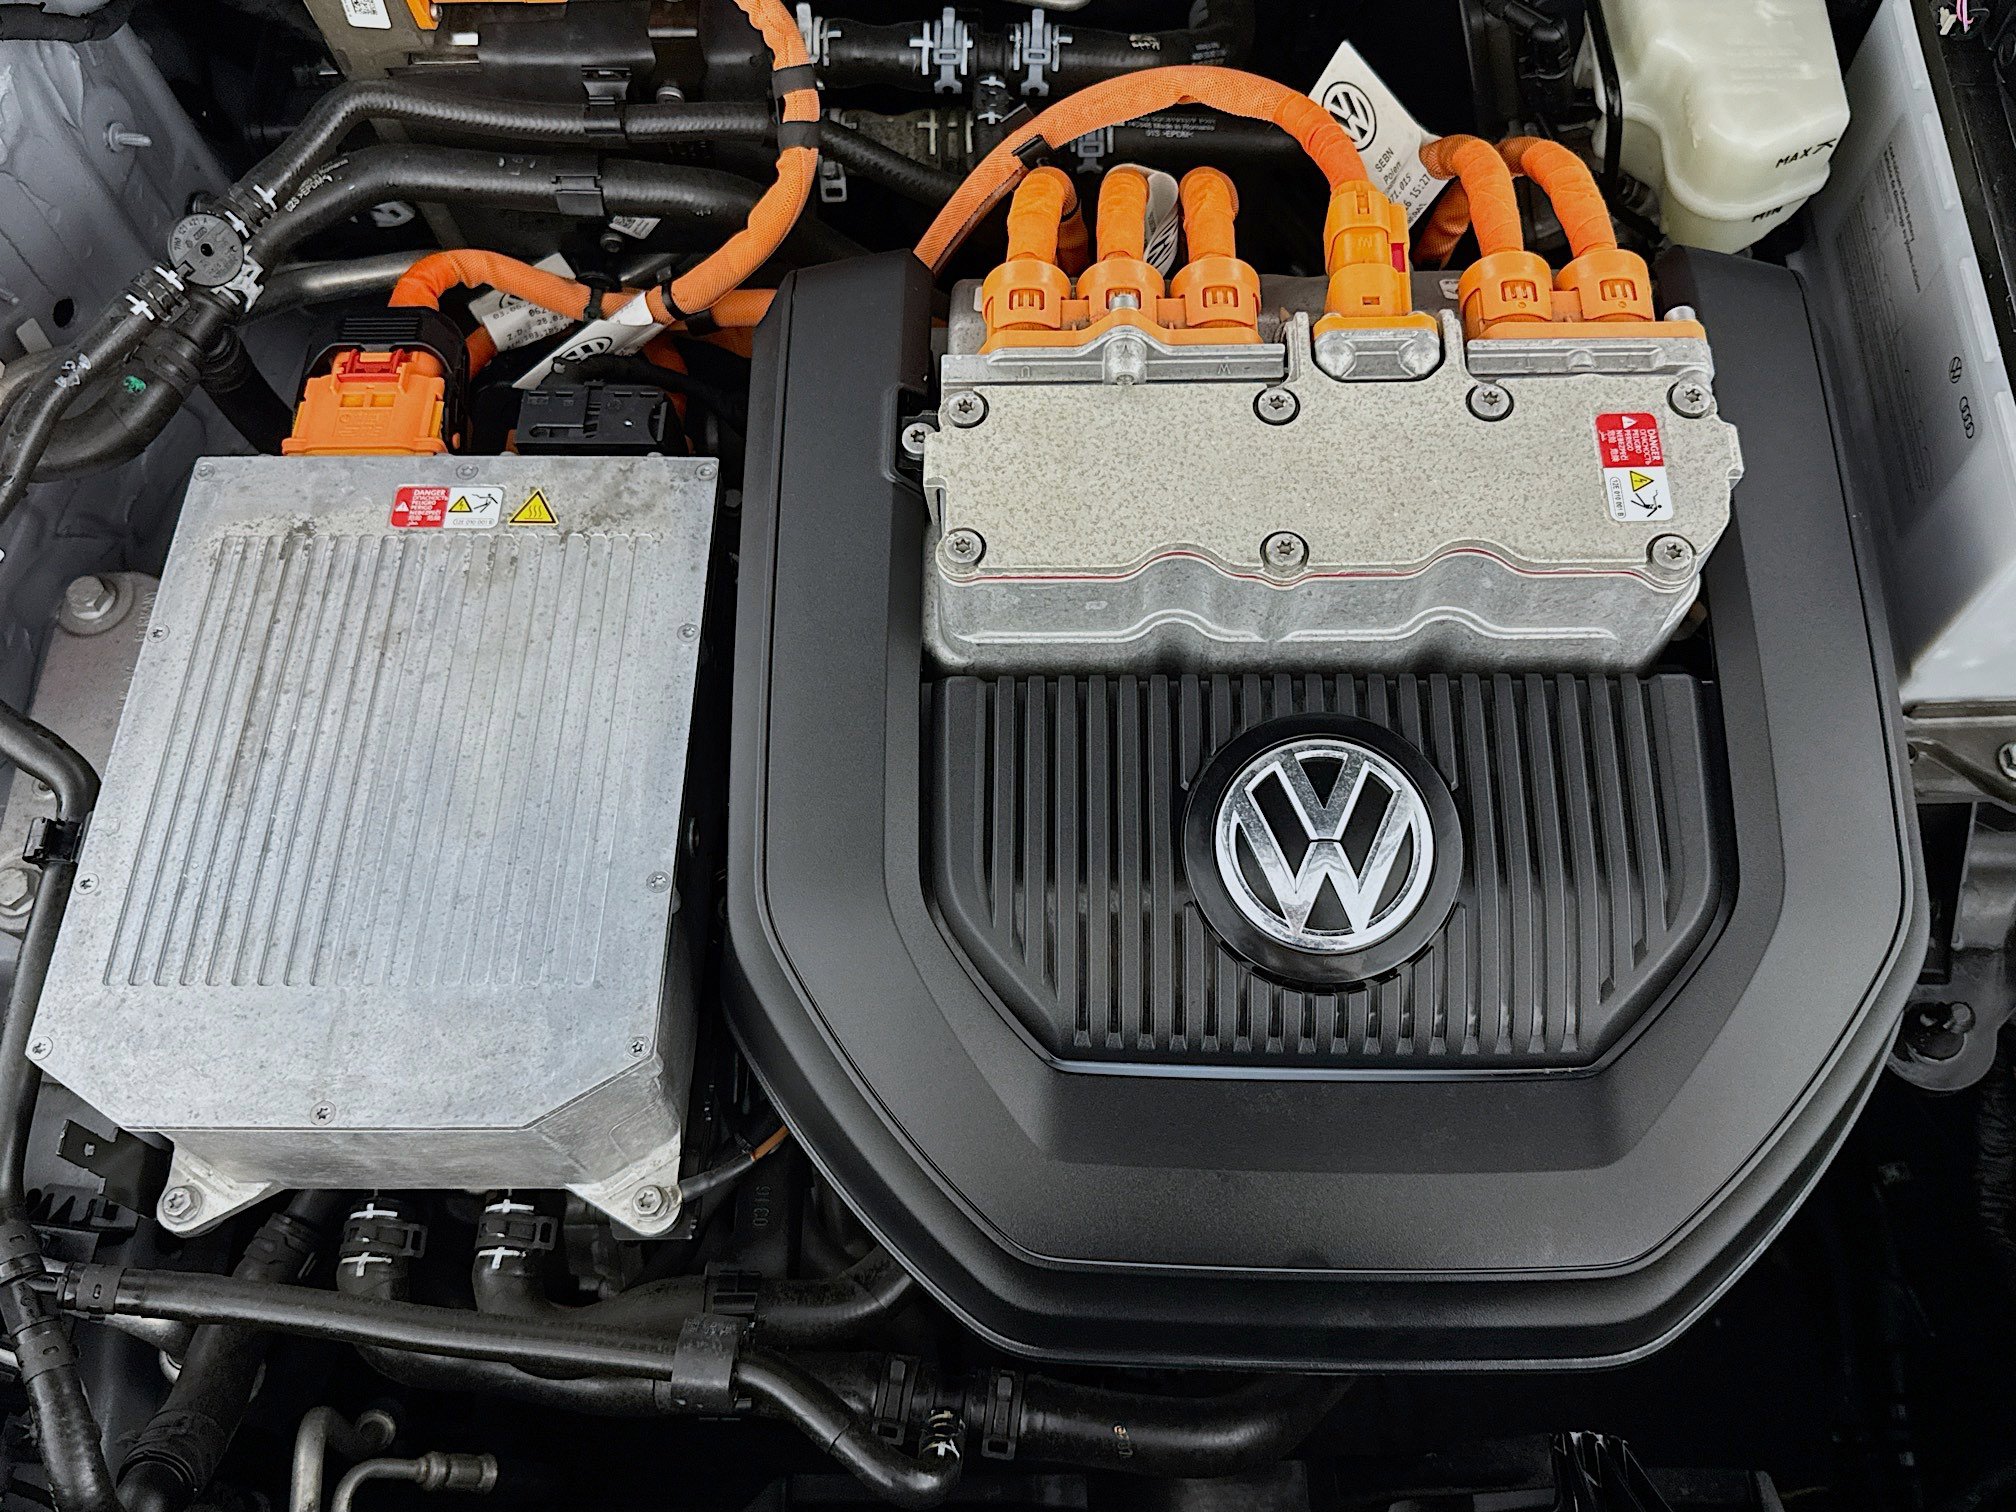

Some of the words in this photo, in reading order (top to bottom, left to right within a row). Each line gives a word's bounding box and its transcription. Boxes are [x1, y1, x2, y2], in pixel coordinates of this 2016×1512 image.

[1375, 147, 1395, 173] SEBN
[1775, 147, 1812, 168] MAX
[1410, 173, 1431, 199] 15:27
[1647, 428, 1661, 461] DANGER
[1215, 737, 1435, 953] VW
